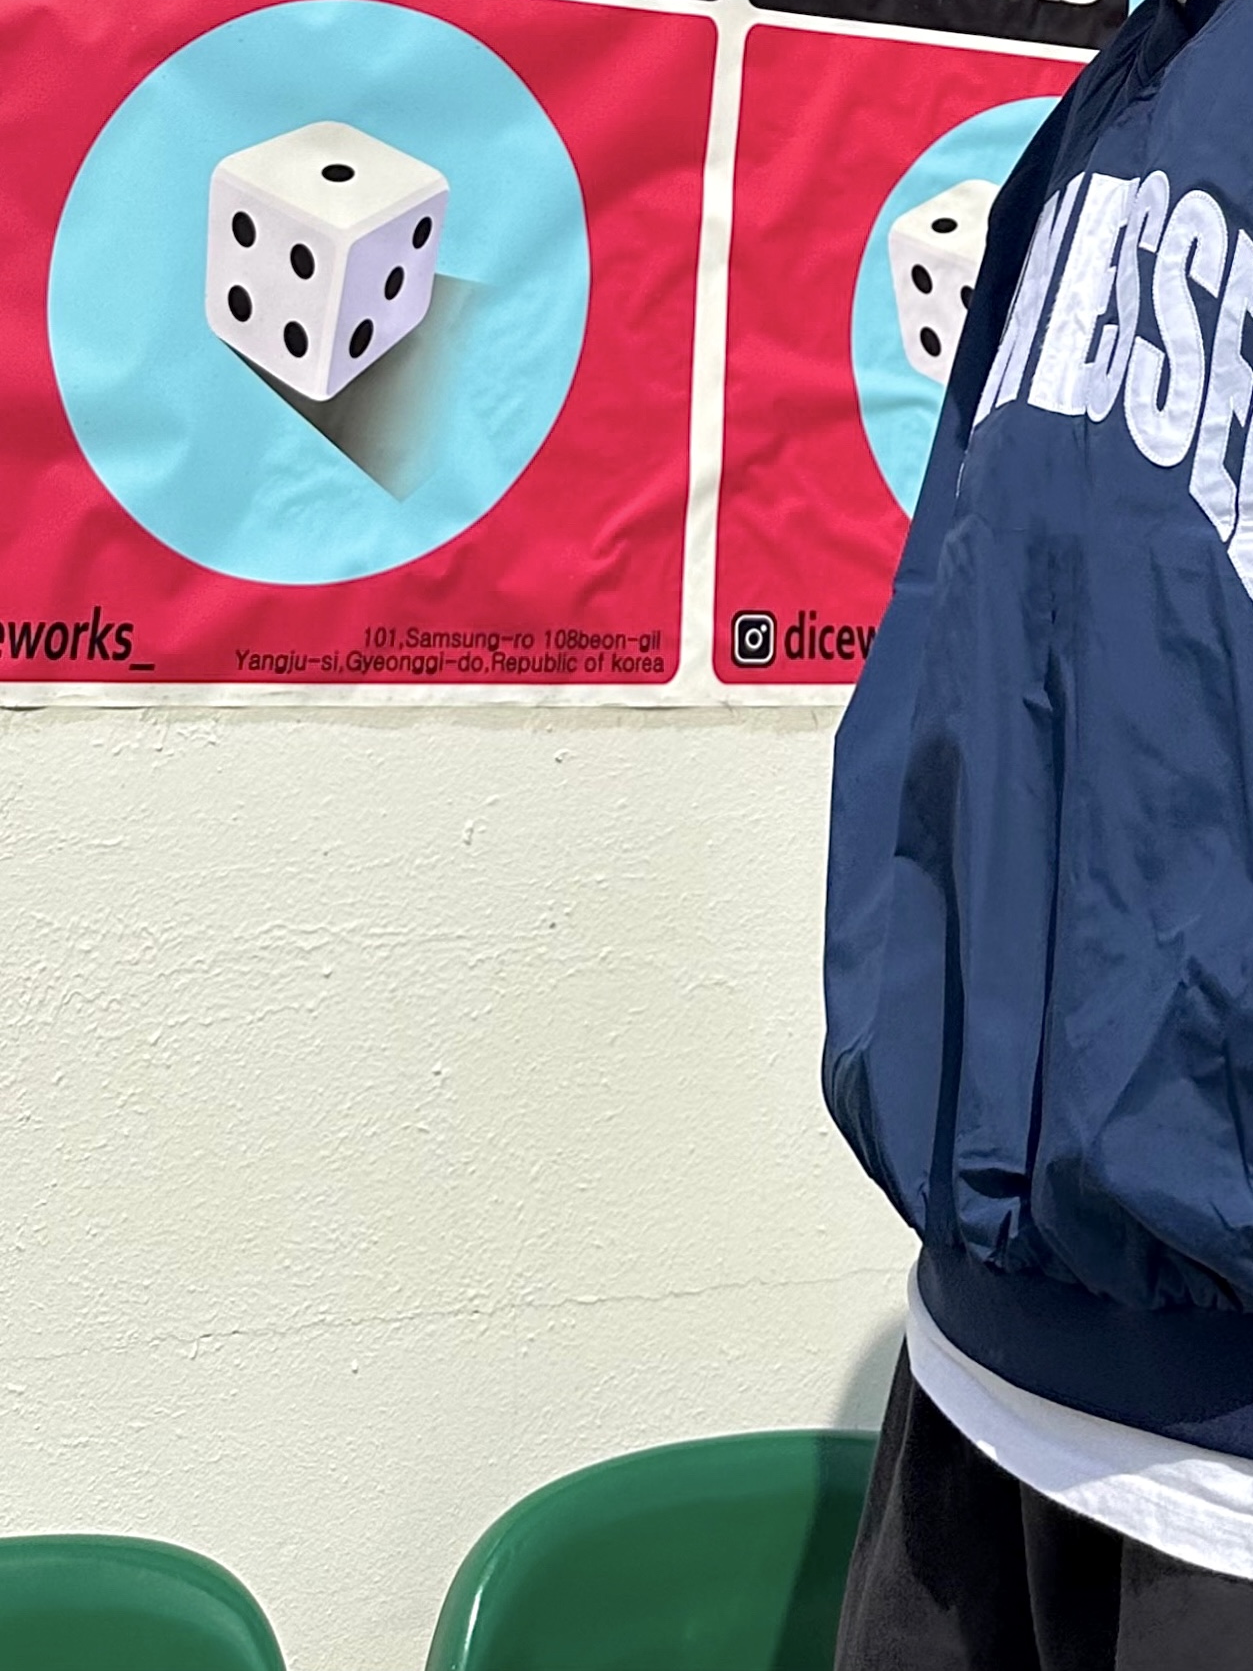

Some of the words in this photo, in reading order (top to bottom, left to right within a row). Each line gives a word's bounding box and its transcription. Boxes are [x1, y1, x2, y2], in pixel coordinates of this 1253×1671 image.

[0, 605, 155, 671] works_
[364, 626, 535, 652] 101,Samsung-ro
[584, 652, 605, 674] of
